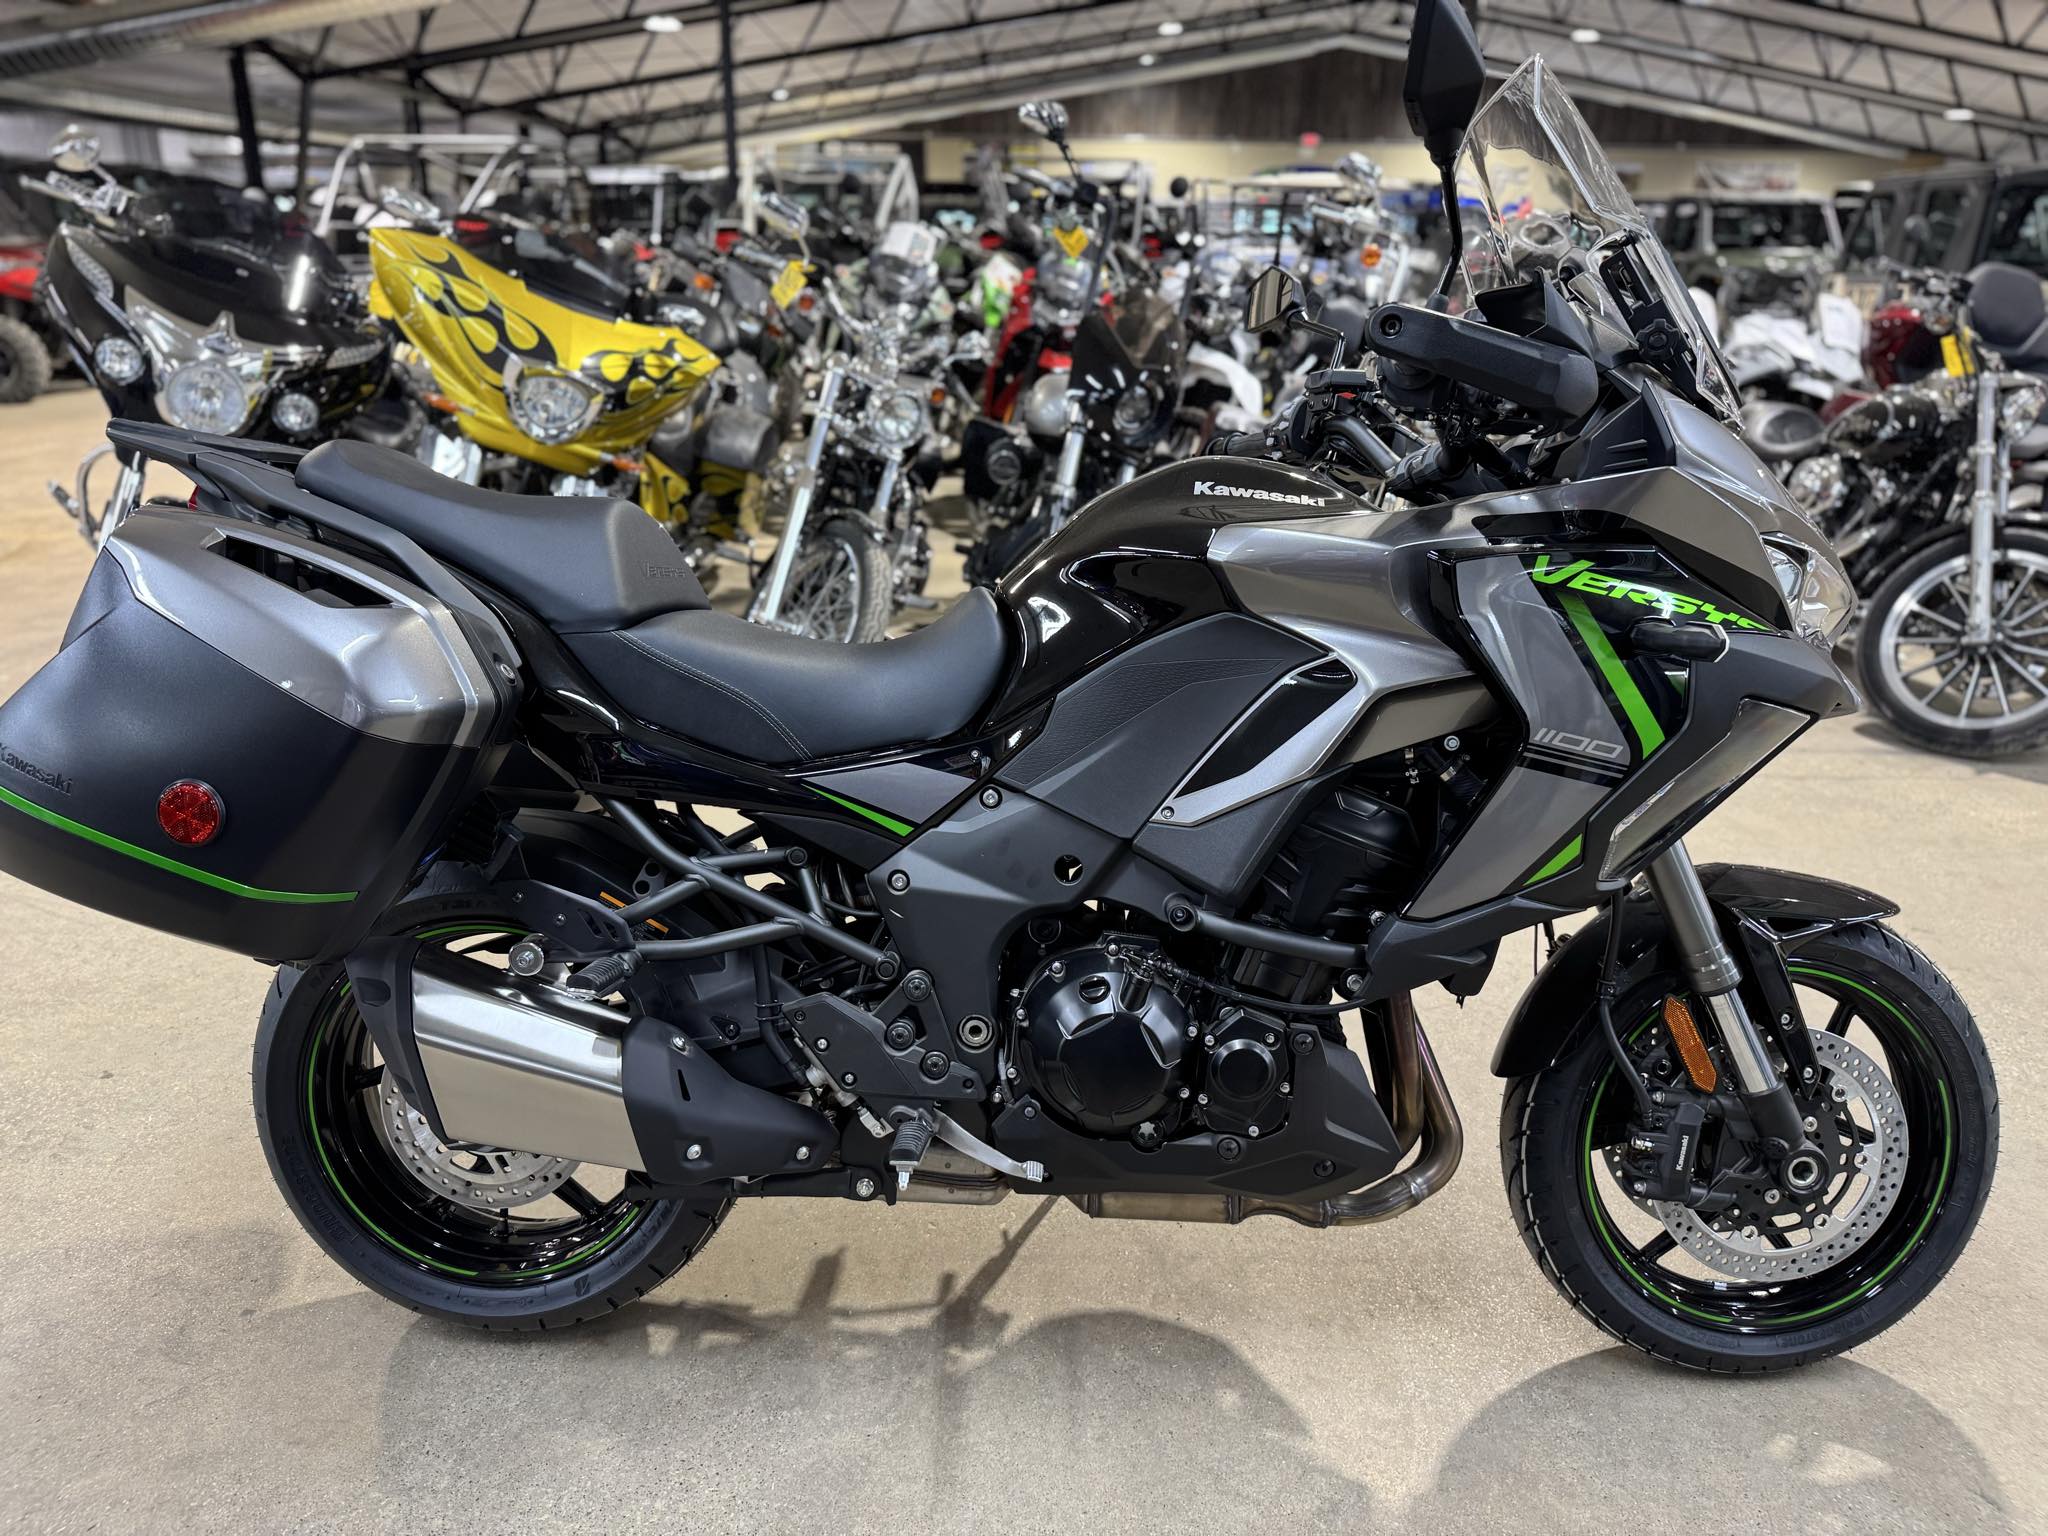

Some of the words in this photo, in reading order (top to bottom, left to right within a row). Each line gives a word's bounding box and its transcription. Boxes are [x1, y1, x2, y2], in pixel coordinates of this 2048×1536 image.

[1193, 481, 1326, 507] Kawasaki
[1534, 731, 1624, 758] 1100
[1675, 1135, 1690, 1171] Kawasaki
